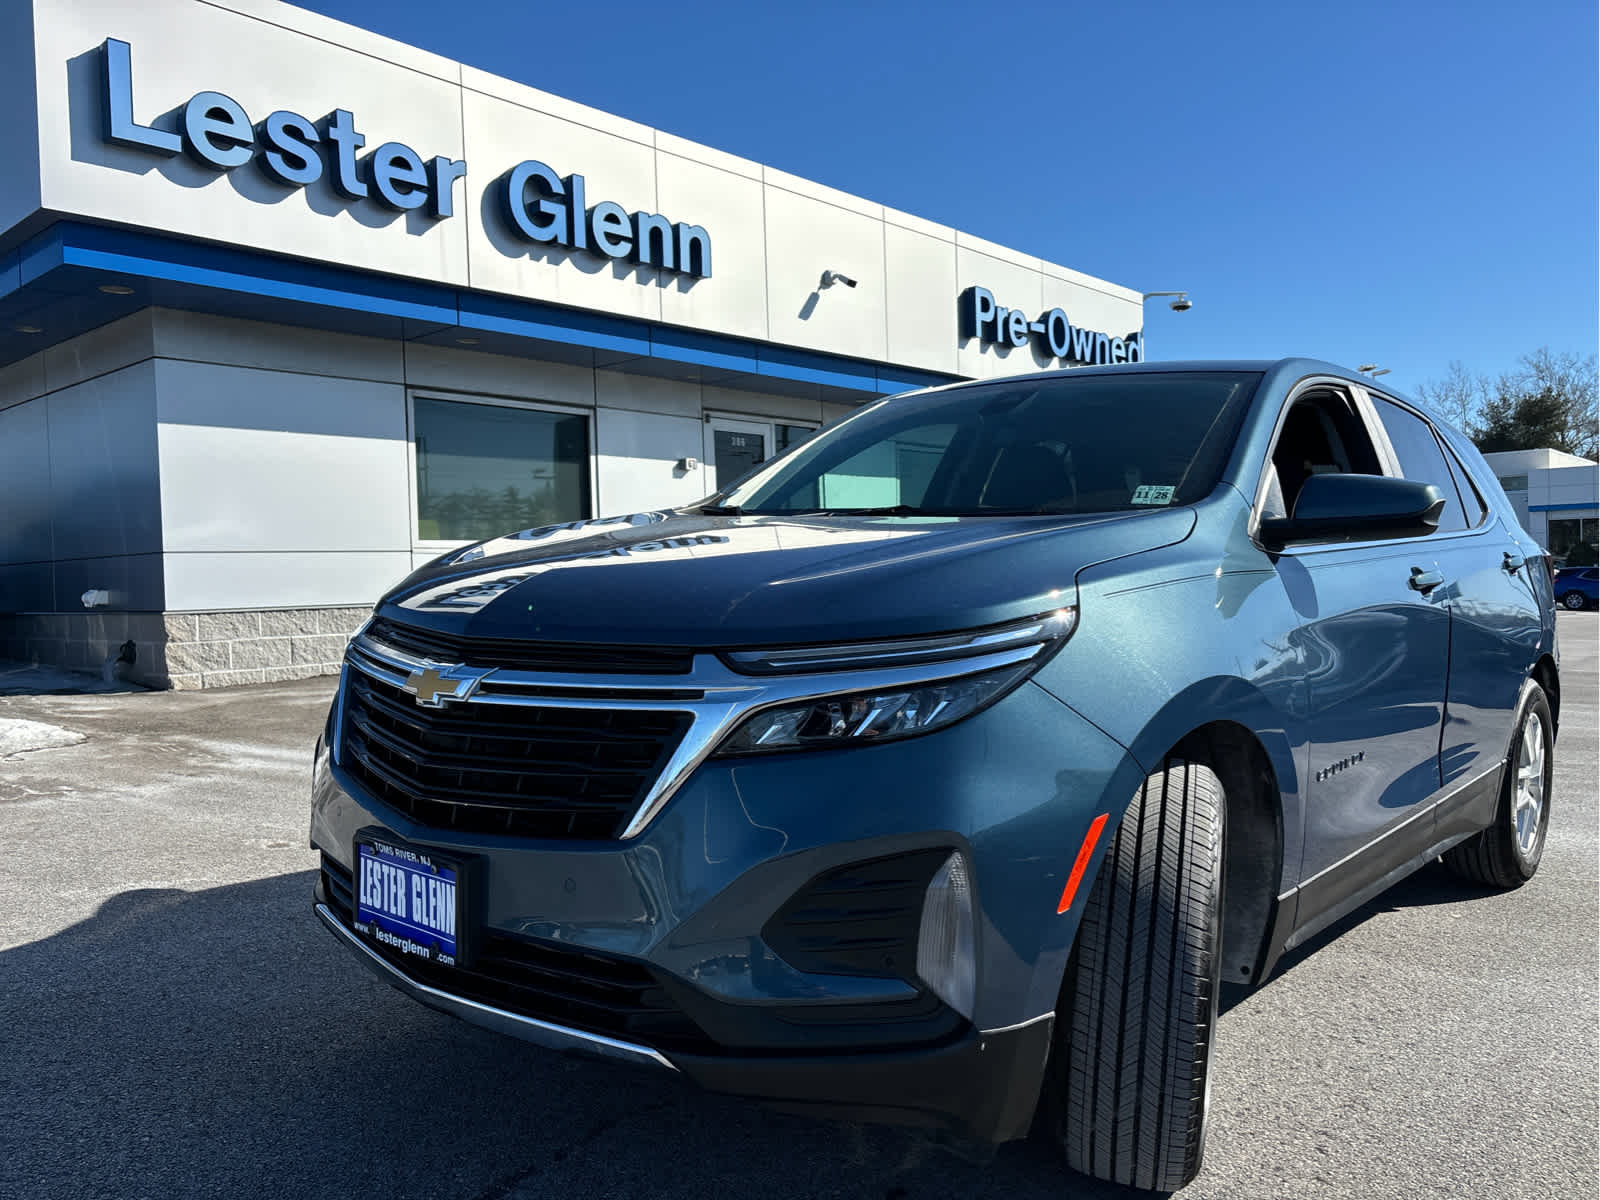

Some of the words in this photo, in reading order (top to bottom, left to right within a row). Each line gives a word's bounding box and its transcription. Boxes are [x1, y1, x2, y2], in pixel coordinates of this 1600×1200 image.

[103, 37, 467, 219] Lester
[505, 159, 712, 279] Glenn
[973, 285, 1143, 364] Pre-Owned
[1136, 490, 1149, 499] 11
[1154, 491, 1169, 500] 28
[374, 842, 395, 856] TOMS
[420, 855, 431, 866] NJ
[360, 857, 407, 918] LESTER
[411, 873, 456, 936] GLENN
[375, 927, 430, 958] lesterglenn
